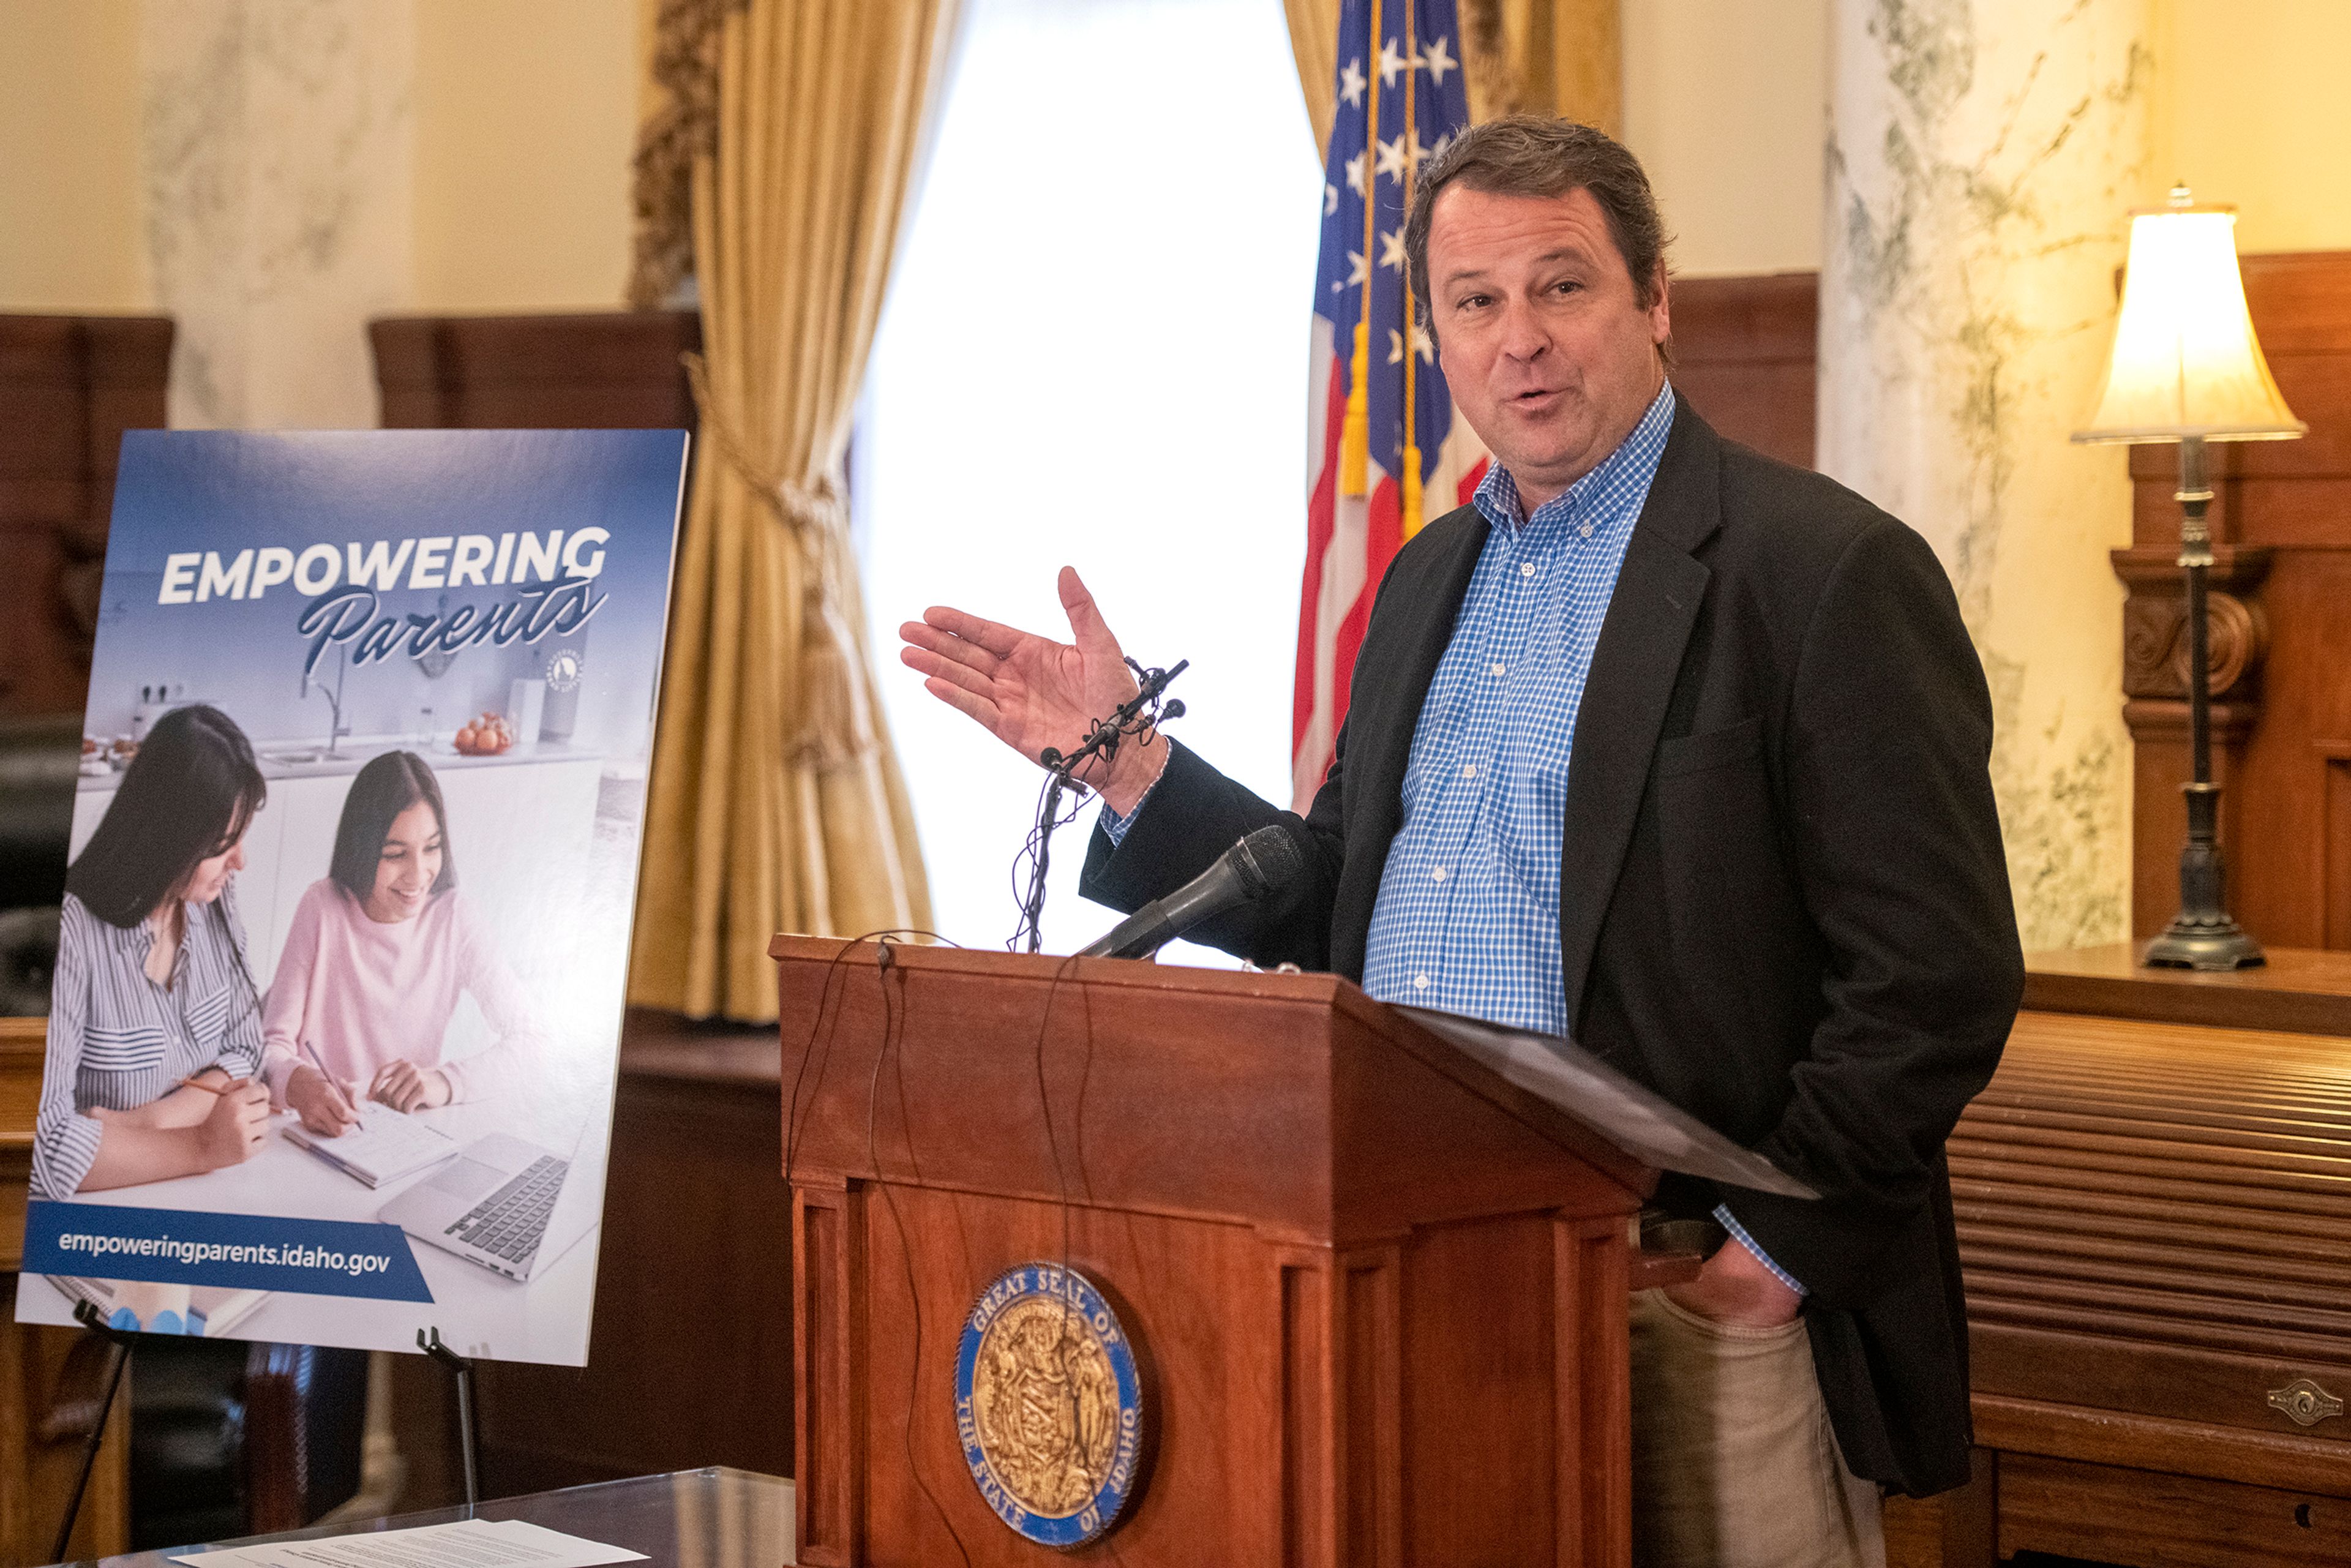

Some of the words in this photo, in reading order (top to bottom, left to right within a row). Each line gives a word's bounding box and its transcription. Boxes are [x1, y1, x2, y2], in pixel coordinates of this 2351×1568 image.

[158, 526, 611, 605] EMPOWERING
[298, 566, 609, 676] Parents
[59, 1232, 391, 1276] empoweringparents.idaho.gov
[973, 1270, 1026, 1333] GREAT
[959, 1395, 980, 1453] THE
[972, 1461, 1027, 1530] STATE
[1108, 1408, 1136, 1494] IDAHO
